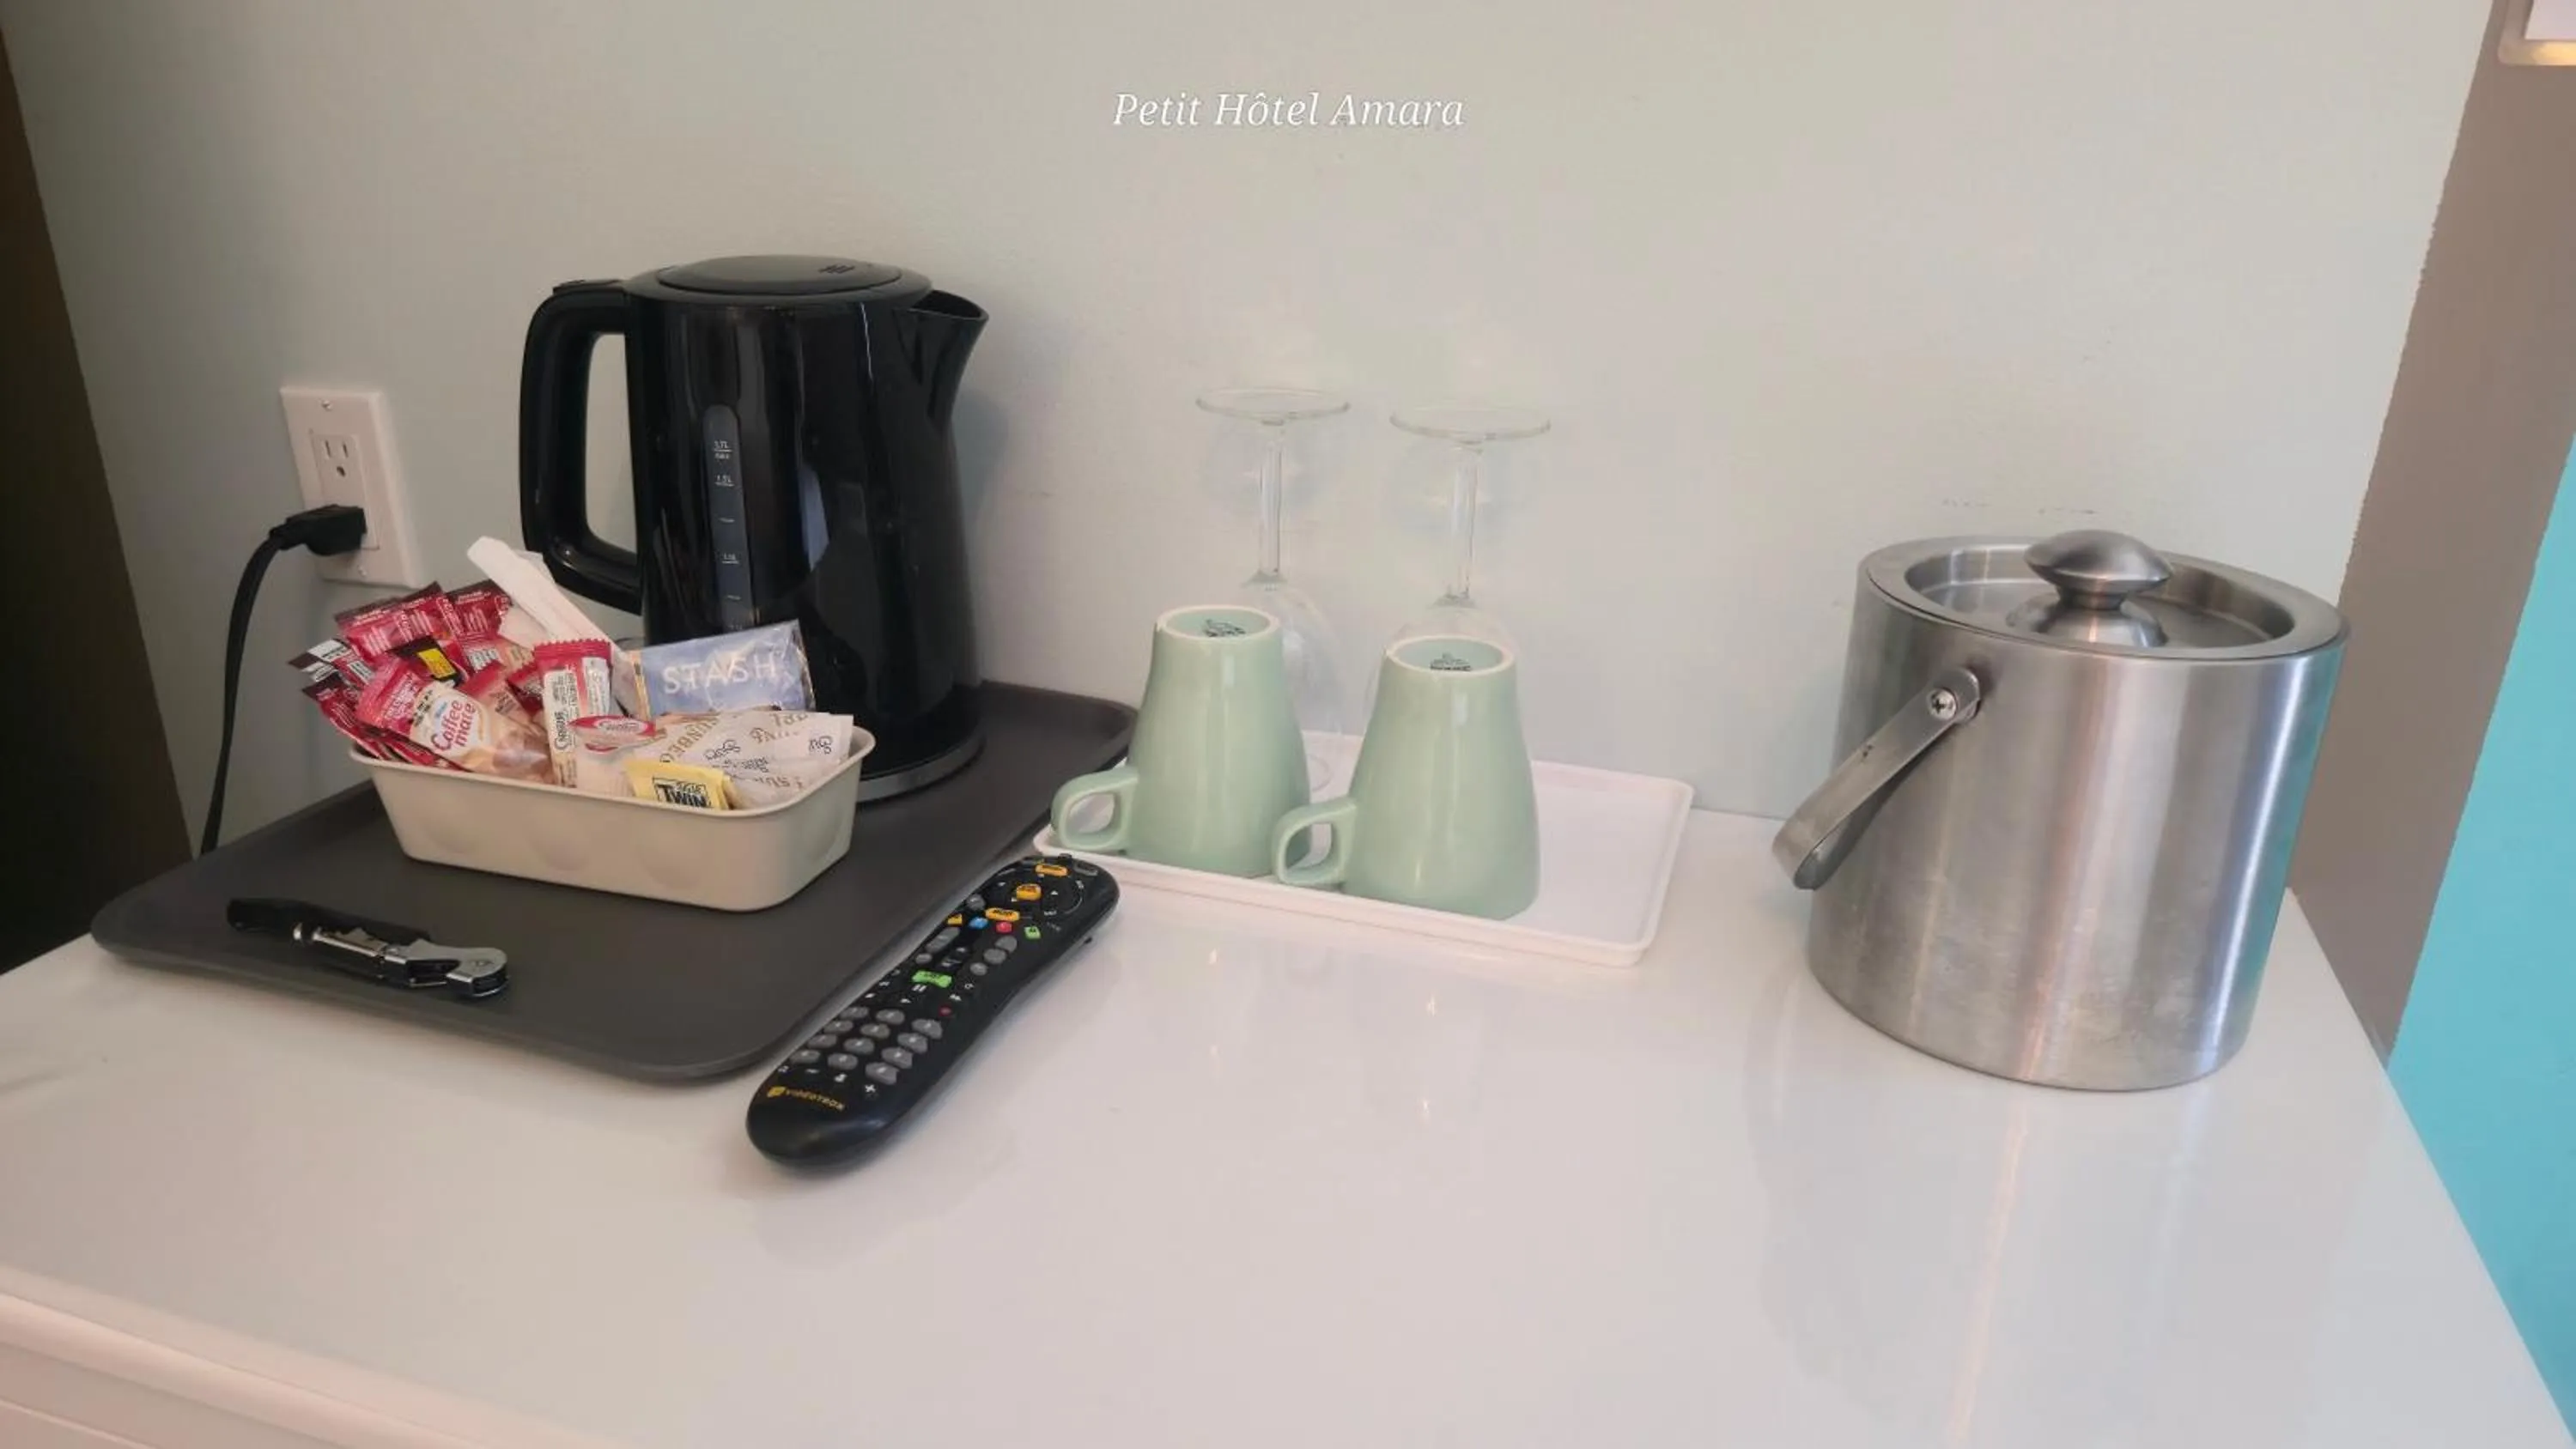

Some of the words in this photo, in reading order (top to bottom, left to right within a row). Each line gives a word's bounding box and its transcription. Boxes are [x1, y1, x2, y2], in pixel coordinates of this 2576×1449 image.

[662, 652, 777, 695] STASH
[431, 700, 463, 751] Coffee
[454, 703, 477, 748] mate
[655, 783, 708, 809] TWIN
